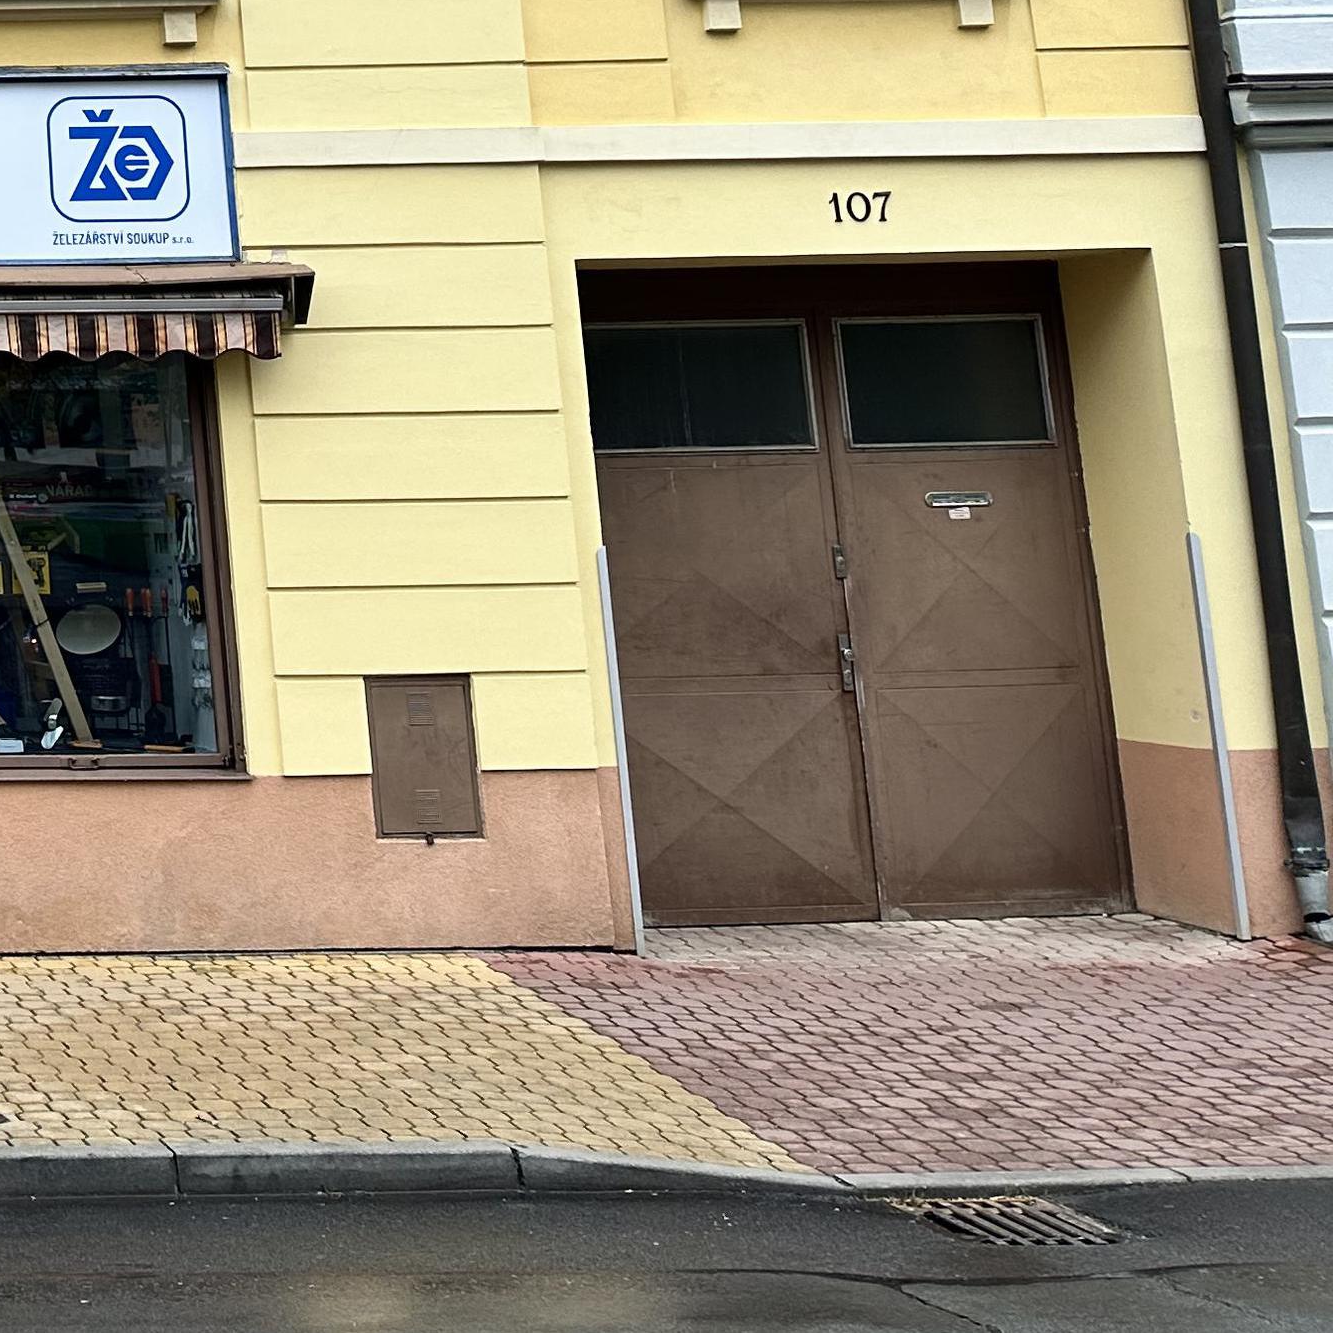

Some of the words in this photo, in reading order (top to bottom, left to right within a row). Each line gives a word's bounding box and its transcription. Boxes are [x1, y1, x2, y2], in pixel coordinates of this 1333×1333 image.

[828, 191, 892, 223] 107
[52, 231, 124, 245] ŽELEZÁŘSTVÍ
[126, 232, 169, 244] SOUKUP
